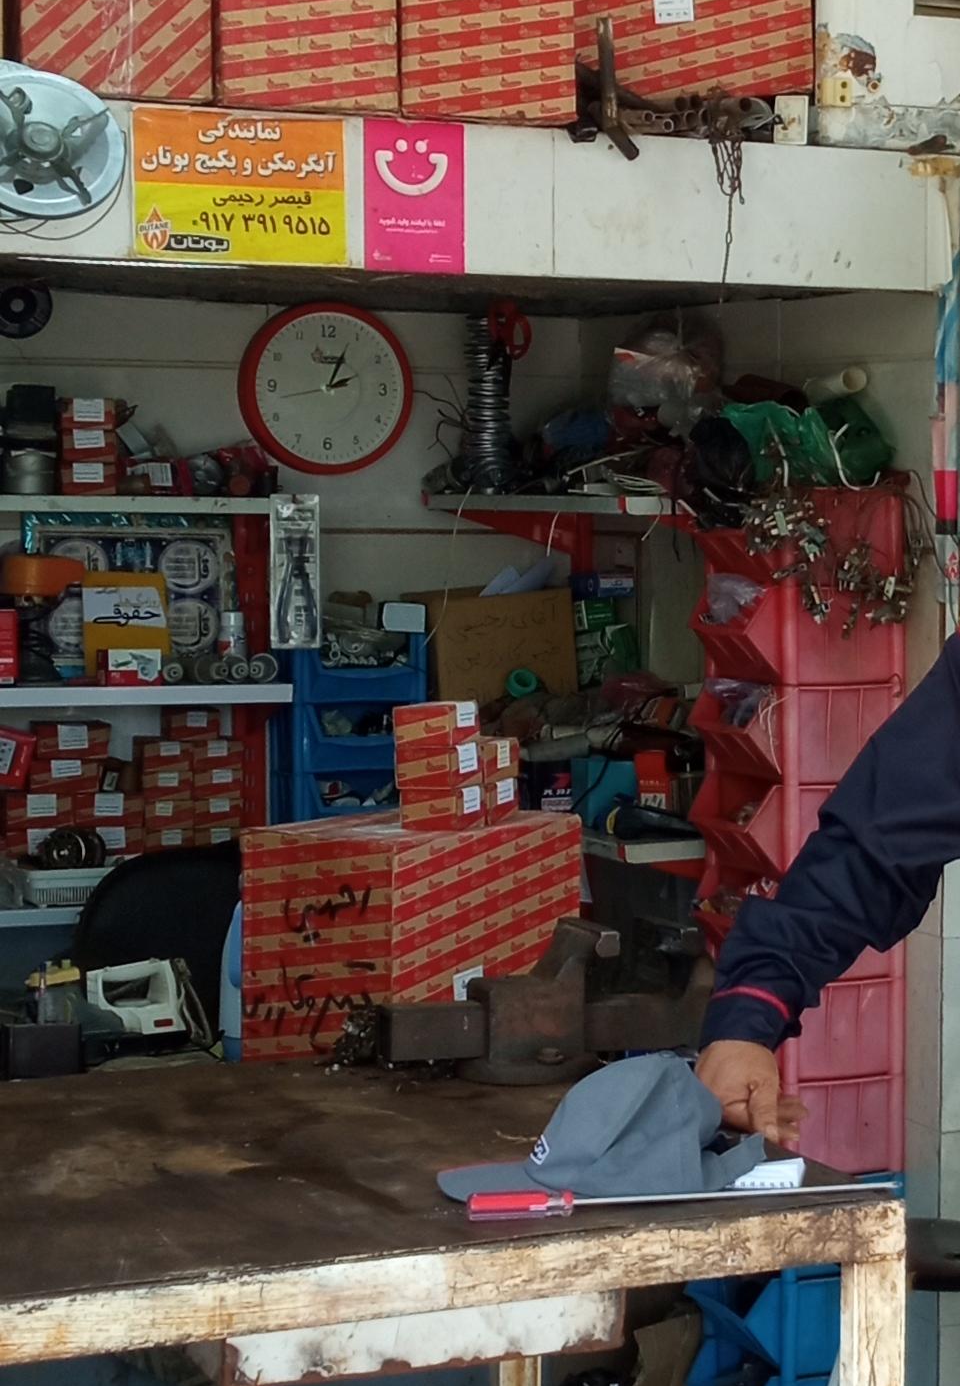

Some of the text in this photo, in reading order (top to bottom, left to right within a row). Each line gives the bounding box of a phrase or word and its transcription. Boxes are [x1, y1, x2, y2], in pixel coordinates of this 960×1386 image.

[198, 118, 281, 144] نمایندگی
[140, 144, 190, 173] بوتان
[194, 148, 237, 176] پکیج
[240, 157, 253, 176] و
[212, 190, 312, 208] قیصر رحیمی
[138, 220, 170, 232] BUTANE
[192, 211, 331, 236] ۰۹۱۷ ۳۹۱ ۹۵۱۵
[169, 235, 229, 253] بوتان
[321, 324, 337, 339] 12
[267, 379, 278, 393] 9
[378, 383, 388, 397] 3
[322, 437, 333, 451] 6
[352, 436, 360, 445] 5
